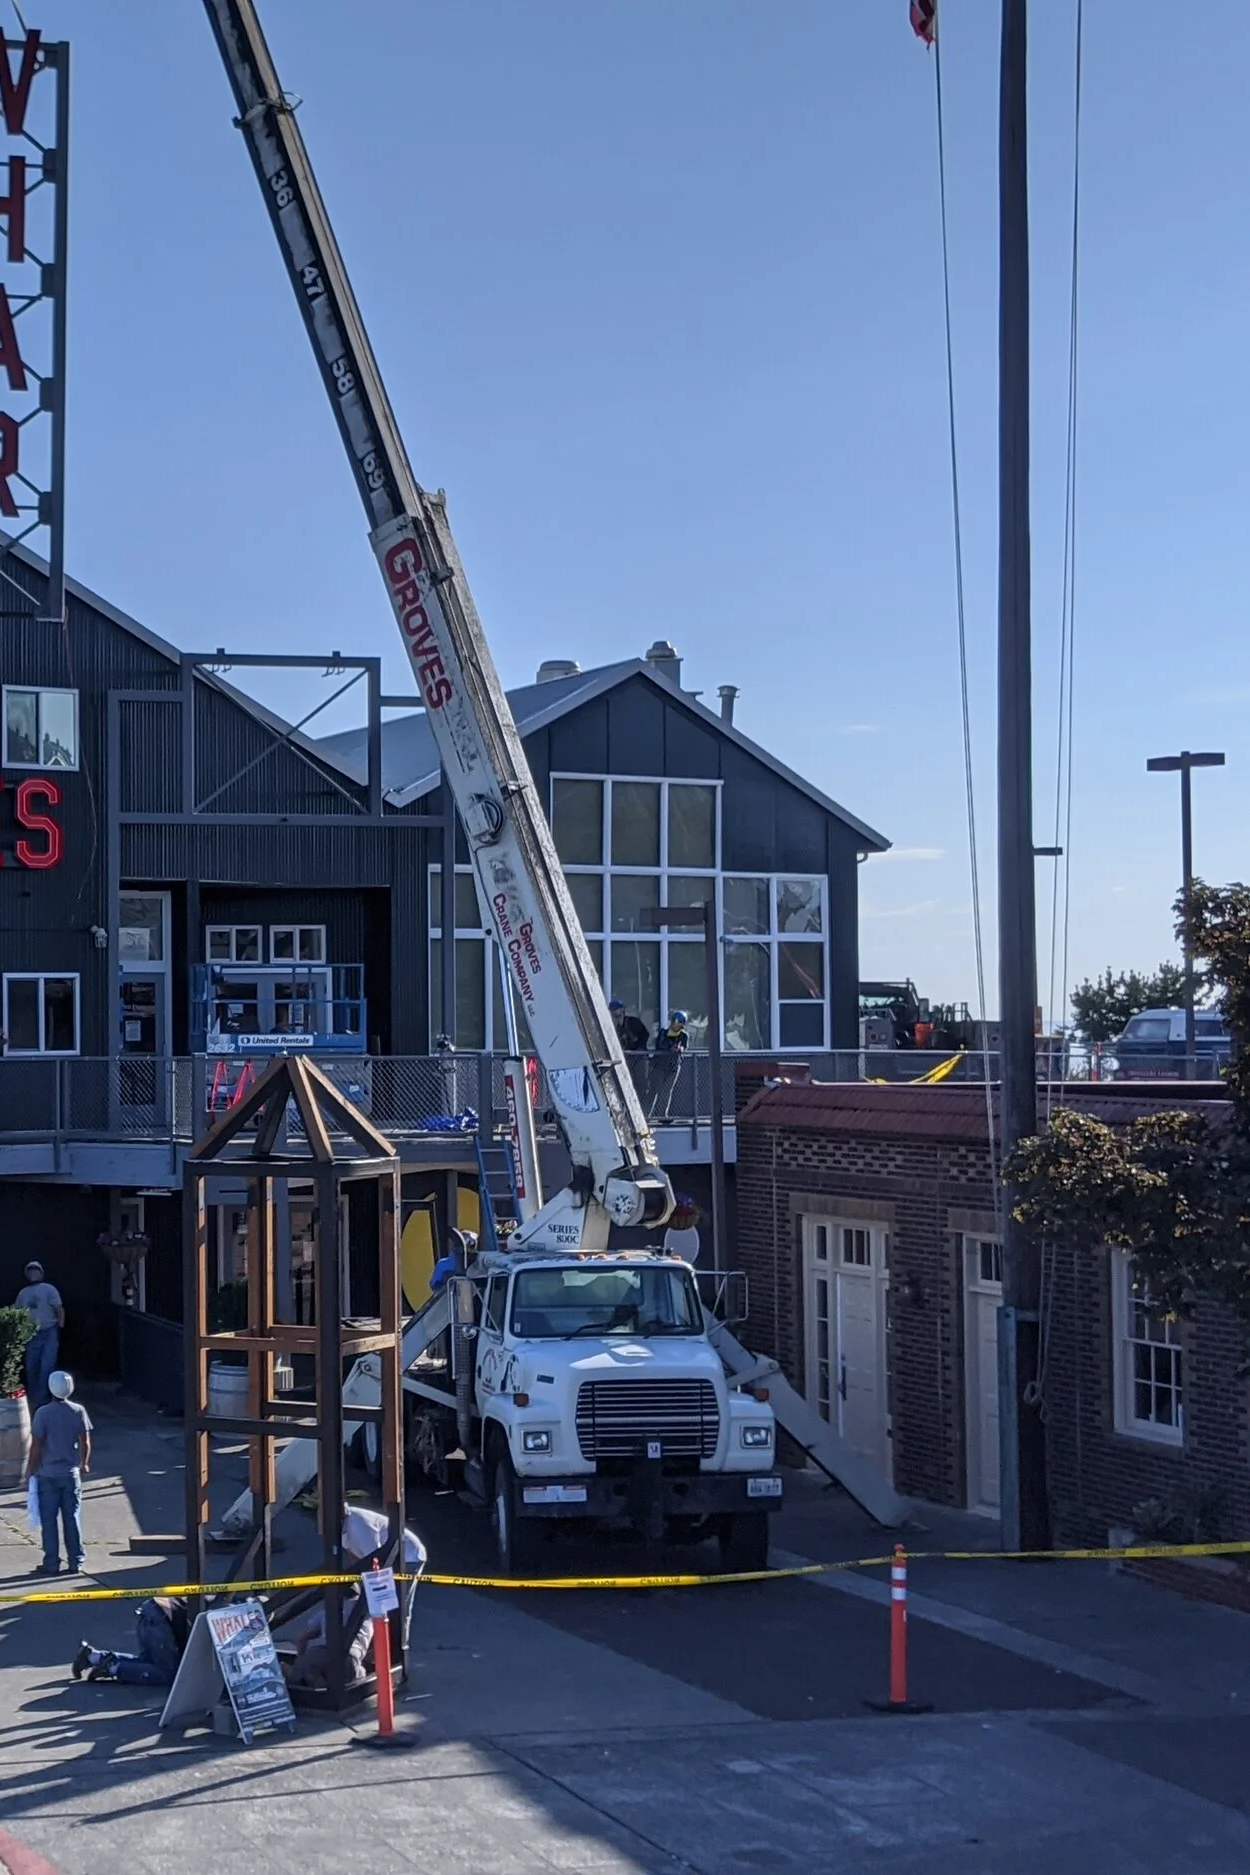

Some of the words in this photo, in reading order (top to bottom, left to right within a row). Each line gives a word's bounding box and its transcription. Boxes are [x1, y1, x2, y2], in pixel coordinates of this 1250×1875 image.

[270, 170, 294, 207] 36
[302, 266, 326, 297] 47
[331, 360, 355, 394] 58
[362, 456, 385, 490] 69
[384, 537, 453, 711] GROVES
[492, 892, 513, 938] CRANE
[507, 939, 535, 1002] COMPANY
[519, 922, 542, 975] GROVES
[251, 1035, 280, 1045] United
[280, 1035, 310, 1045] Rentals
[547, 1223, 580, 1235] SERIES
